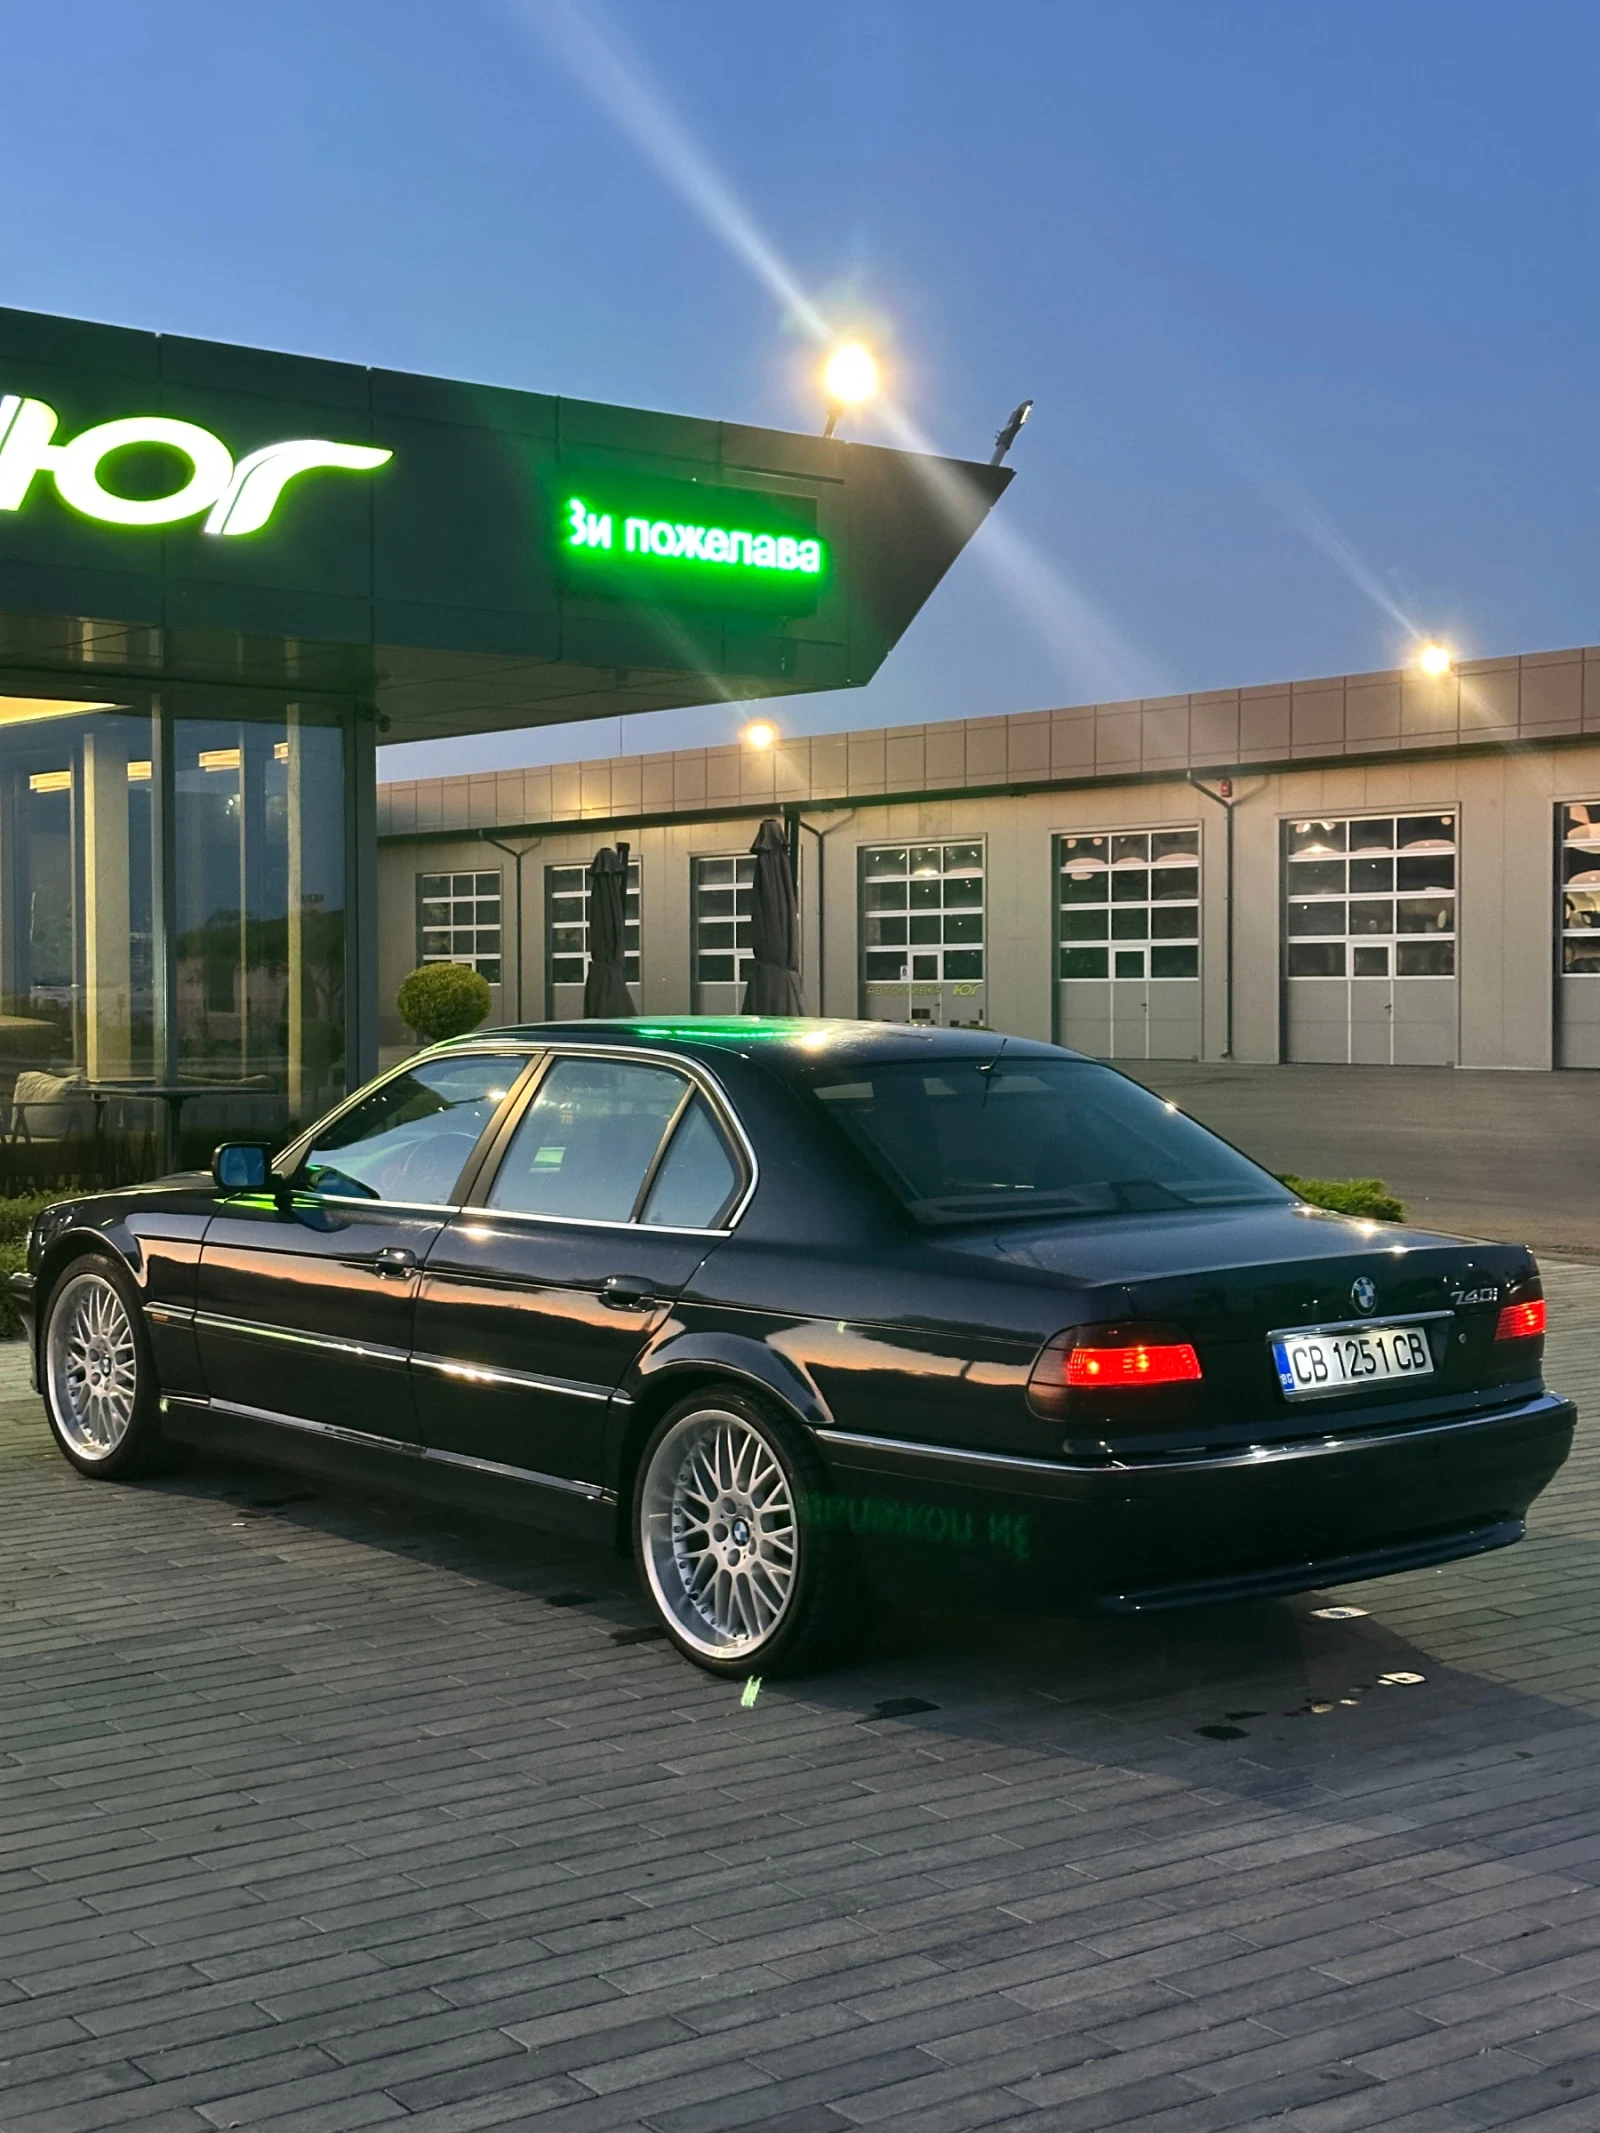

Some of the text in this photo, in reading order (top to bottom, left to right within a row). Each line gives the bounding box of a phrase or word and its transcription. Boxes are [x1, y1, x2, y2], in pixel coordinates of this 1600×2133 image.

[624, 517, 821, 573] пожелава
[1450, 1287, 1498, 1305] 740i
[1292, 1333, 1427, 1385] CB 1251 CB
